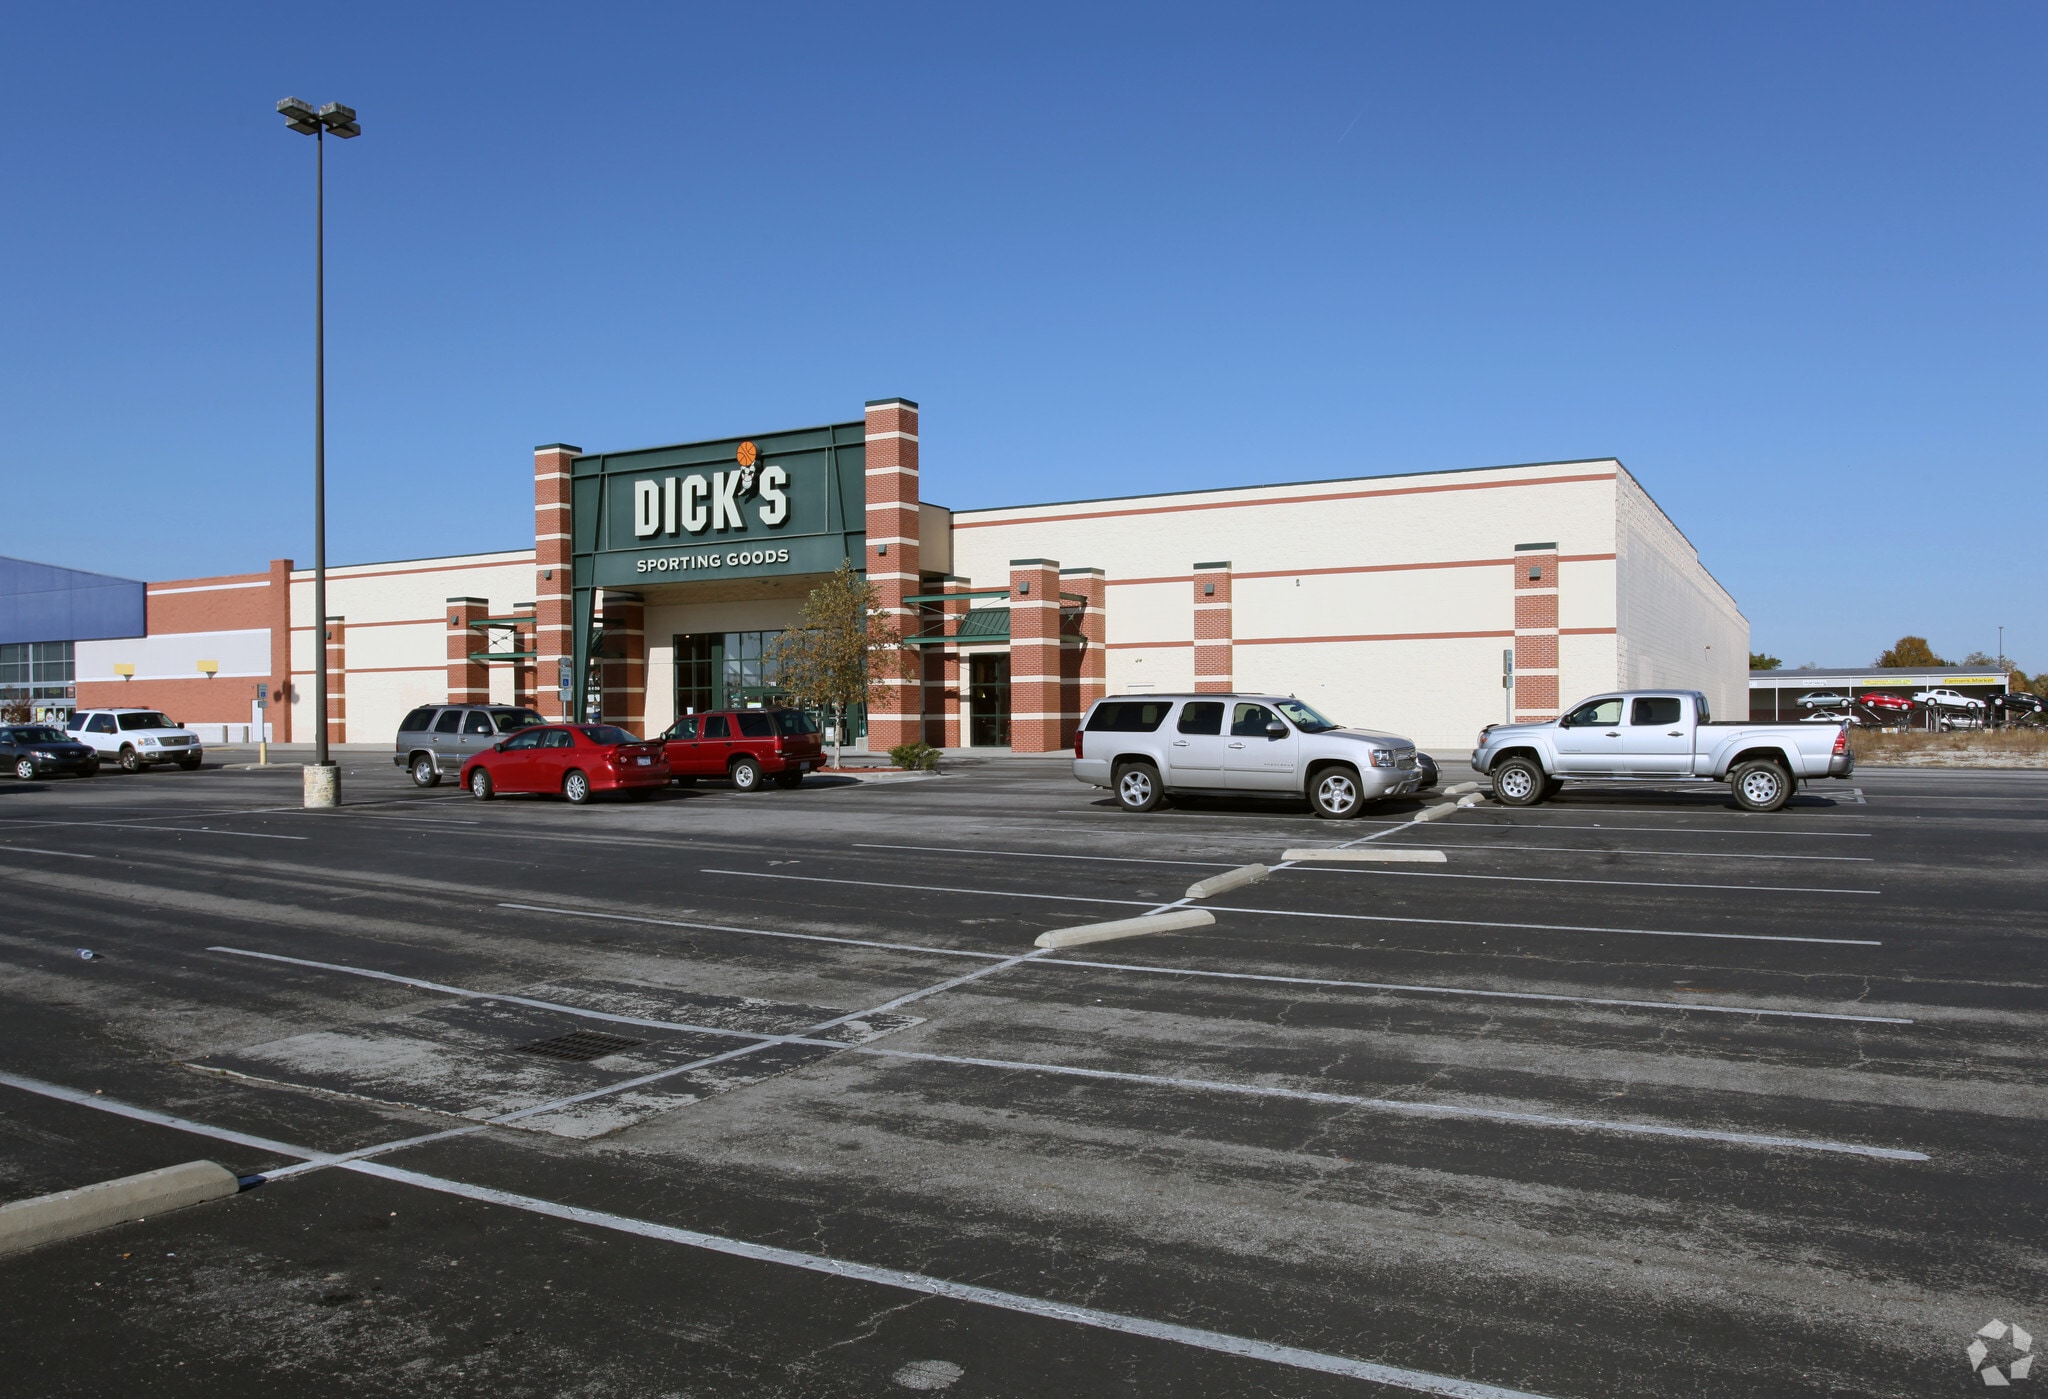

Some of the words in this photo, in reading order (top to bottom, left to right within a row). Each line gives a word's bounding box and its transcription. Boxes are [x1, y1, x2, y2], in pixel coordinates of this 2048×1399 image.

[634, 465, 787, 537] DICK'S
[636, 554, 721, 573] SPORTING
[726, 549, 790, 567] GOODS
